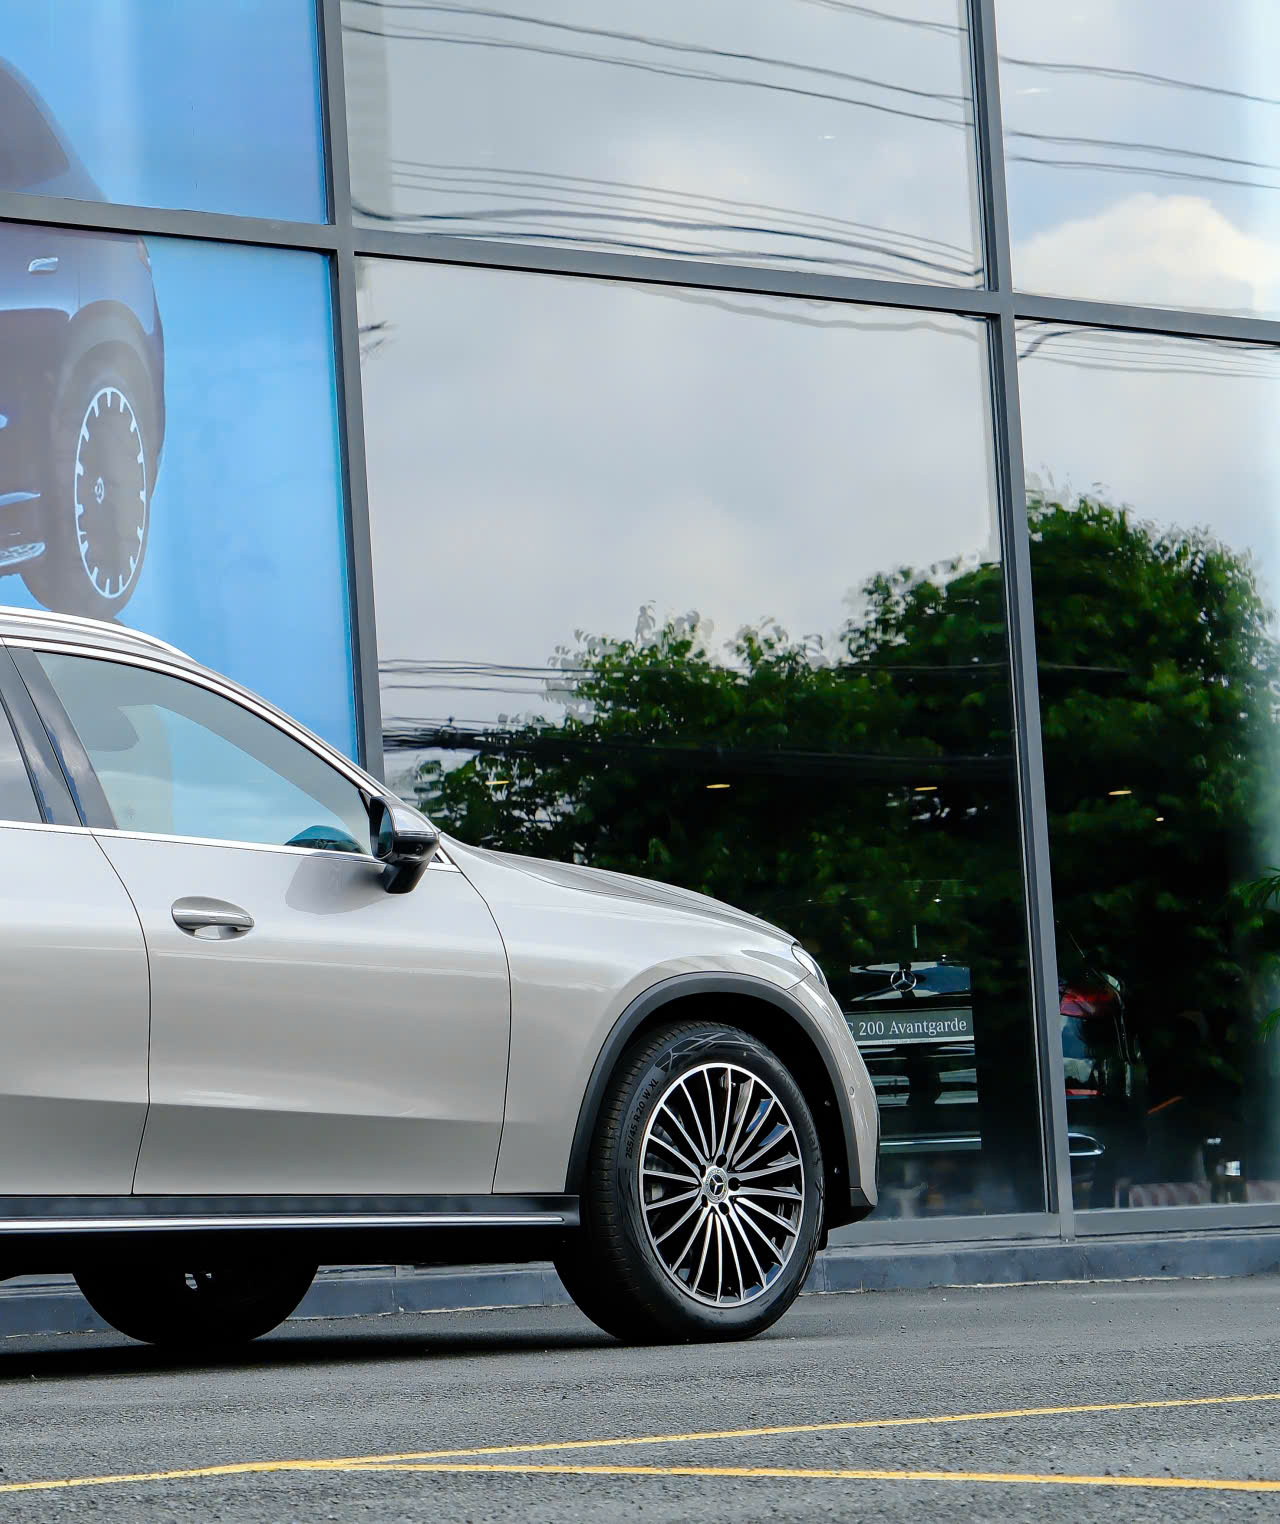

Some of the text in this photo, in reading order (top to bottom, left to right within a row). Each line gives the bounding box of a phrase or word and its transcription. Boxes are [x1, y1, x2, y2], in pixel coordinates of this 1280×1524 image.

[858, 1021, 884, 1036] 200
[889, 1018, 967, 1036] Avantgarde
[626, 1123, 638, 1160] 255/45
